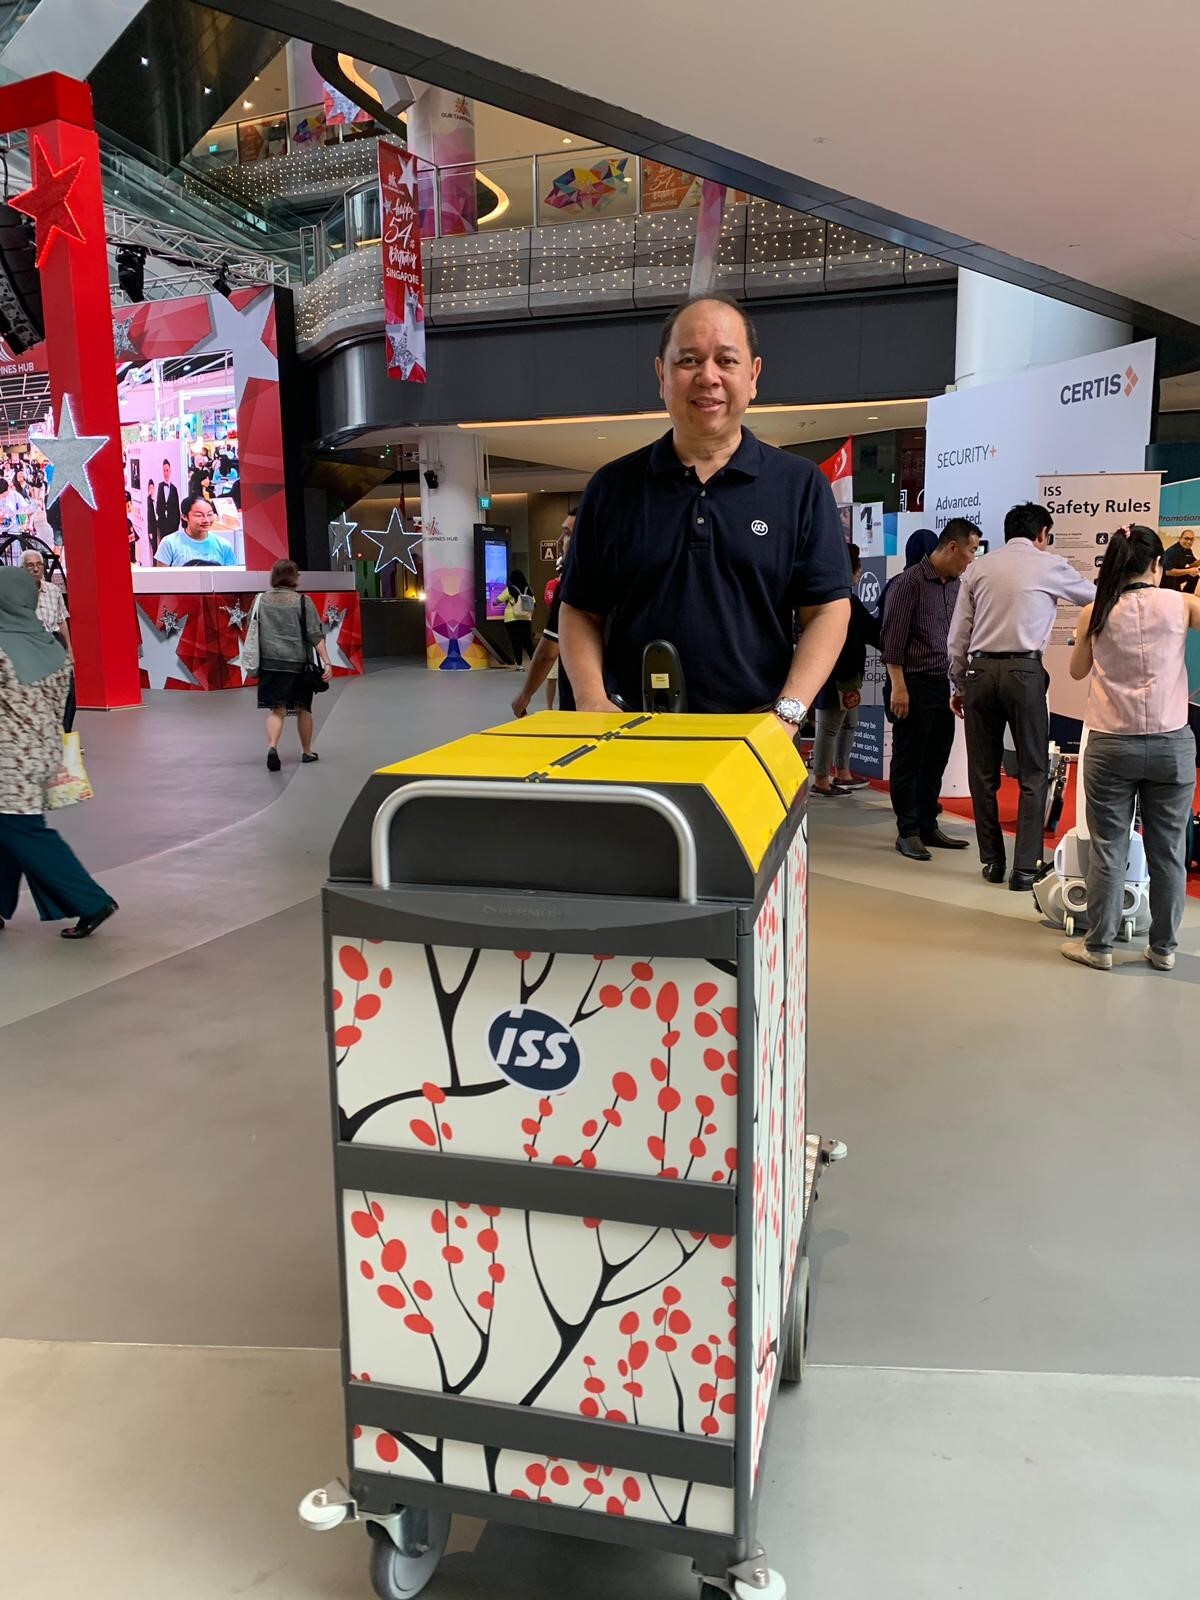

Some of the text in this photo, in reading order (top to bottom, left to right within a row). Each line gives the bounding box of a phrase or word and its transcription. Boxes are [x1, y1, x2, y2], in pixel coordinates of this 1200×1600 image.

[386, 267, 420, 285] SINGAPORE
[18, 361, 35, 372] HUB
[1060, 373, 1122, 406] CERTIS
[935, 491, 982, 511] Advanced.
[1043, 486, 1062, 497] ISS
[1046, 498, 1151, 517] Safety Rules
[544, 548, 555, 560] A
[861, 583, 879, 602] ISS
[495, 1026, 572, 1071] ISS
